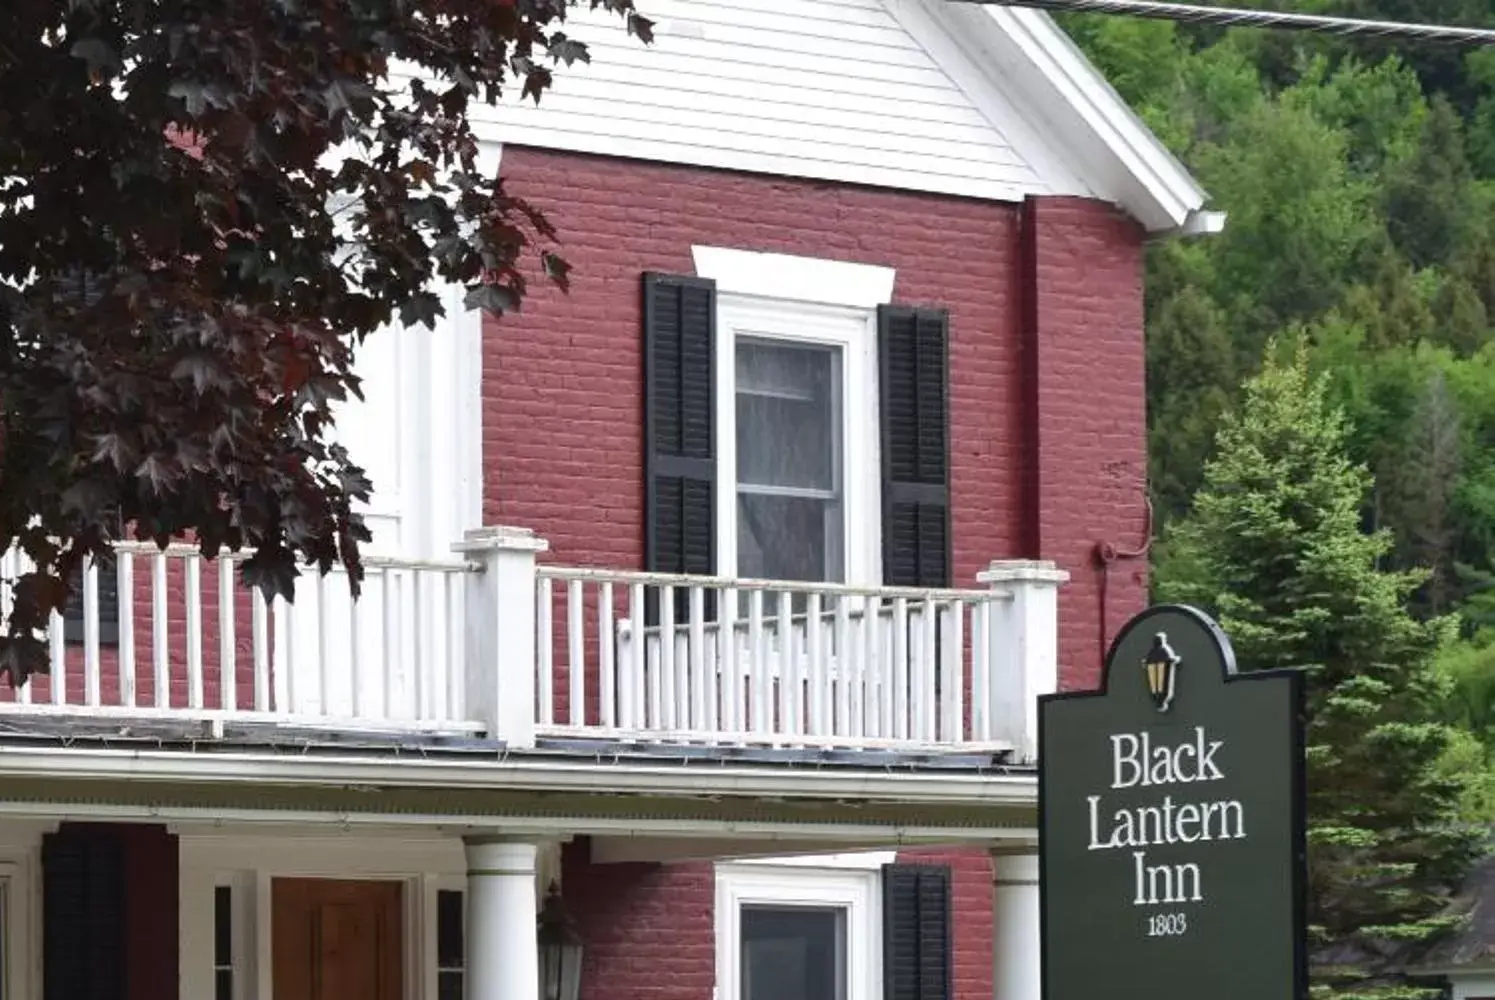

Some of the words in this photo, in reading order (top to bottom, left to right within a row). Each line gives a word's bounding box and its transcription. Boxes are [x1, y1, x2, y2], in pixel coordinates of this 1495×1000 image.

[1110, 726, 1225, 788] Black
[1087, 795, 1247, 851] Lantern
[1133, 851, 1204, 905] Inn
[1148, 912, 1187, 937] 1803
